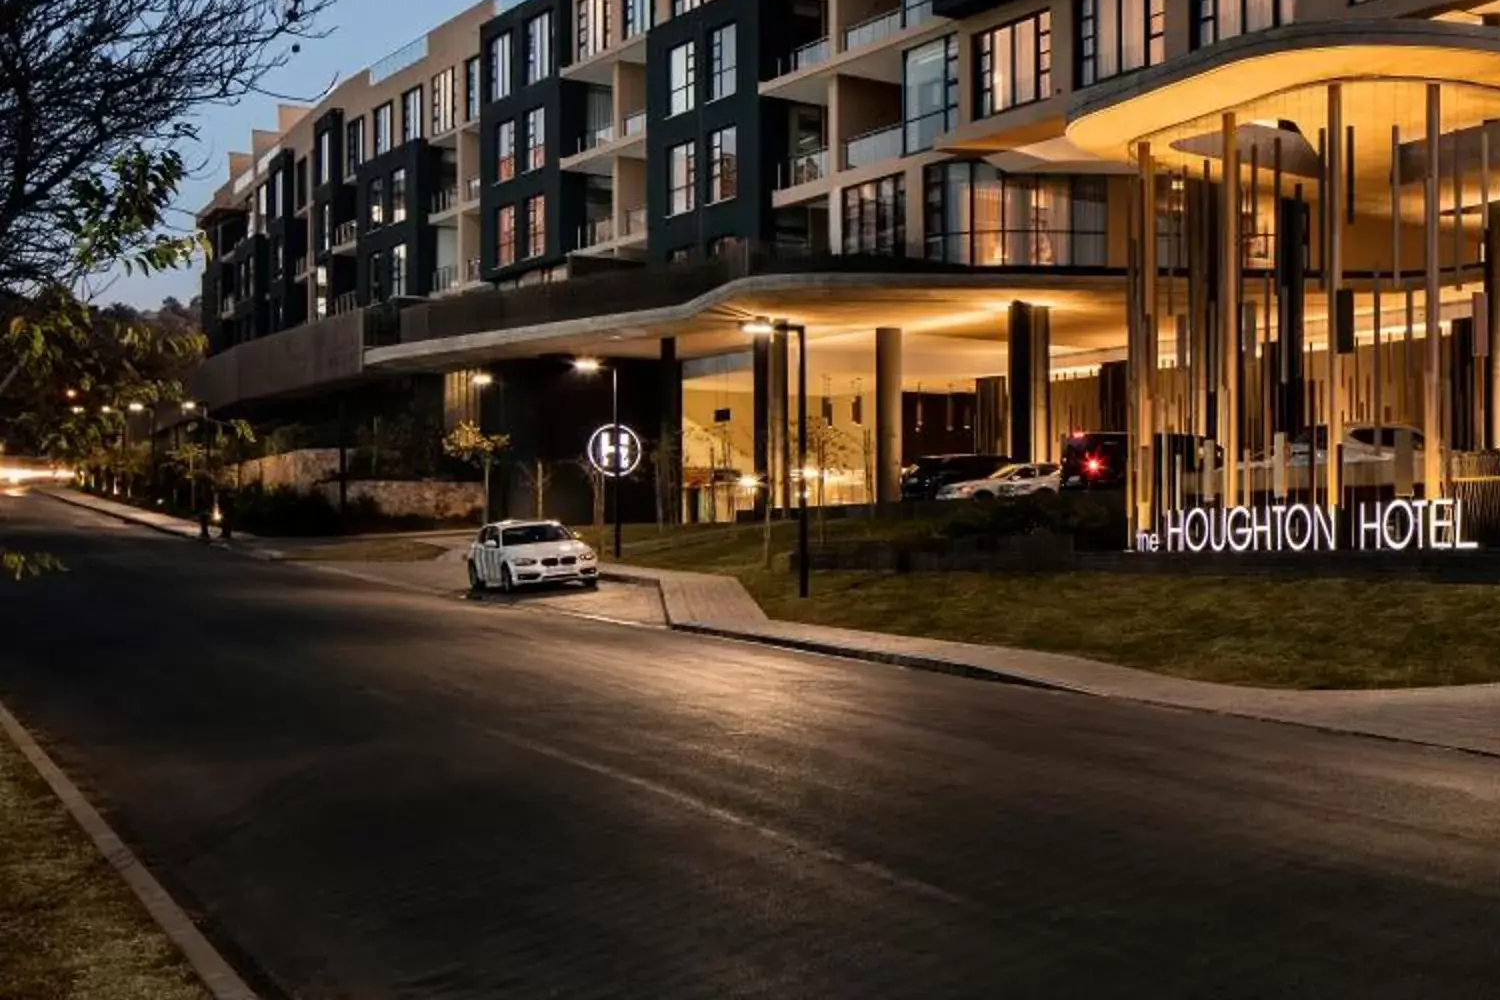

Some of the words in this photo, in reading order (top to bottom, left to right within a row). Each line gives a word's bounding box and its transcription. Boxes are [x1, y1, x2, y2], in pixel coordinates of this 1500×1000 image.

[601, 431, 629, 468] H
[1167, 503, 1336, 551] HOUGHTON
[1360, 499, 1479, 550] HOTEL
